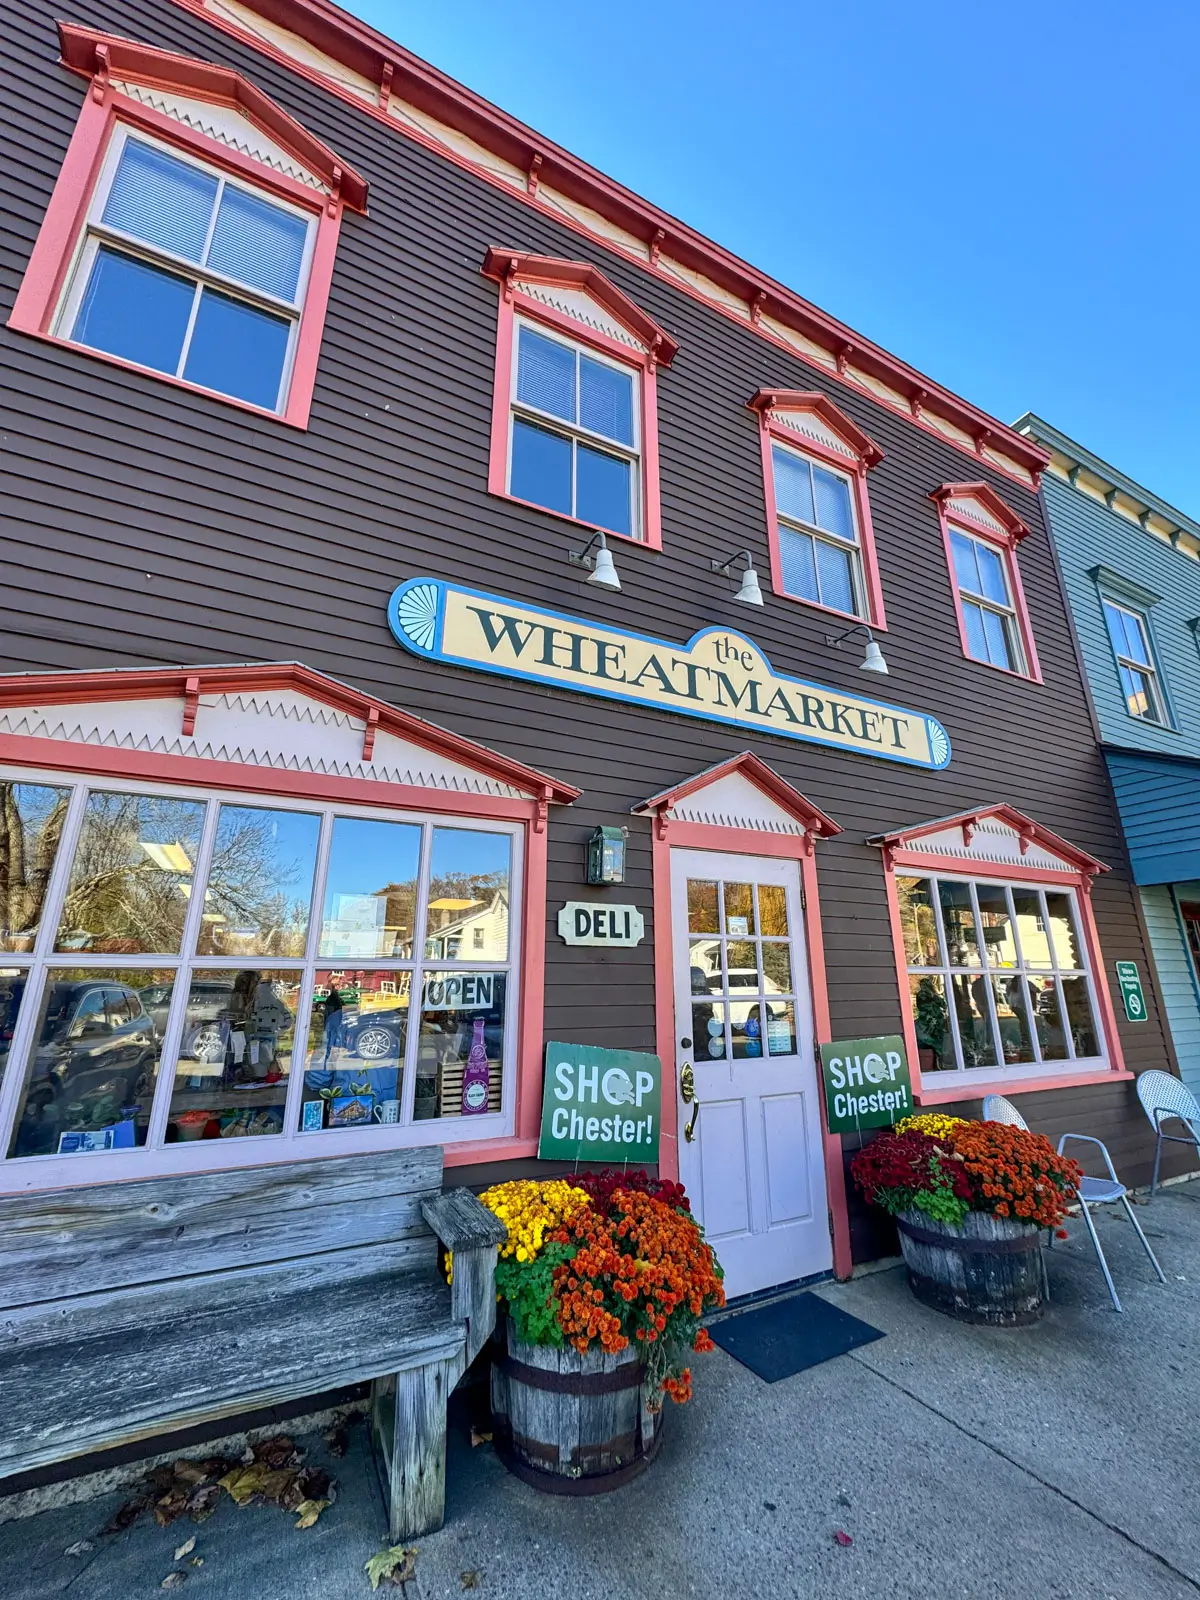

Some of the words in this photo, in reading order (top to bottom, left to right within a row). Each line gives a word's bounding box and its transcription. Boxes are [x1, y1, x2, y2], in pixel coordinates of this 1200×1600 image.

[712, 637, 754, 672] the
[574, 908, 631, 939] DELI
[427, 976, 491, 1006] OPEN
[553, 1062, 654, 1107] SHOP
[829, 1051, 902, 1089] SHOP
[834, 1084, 908, 1118] Chester!
[551, 1107, 653, 1145] Chester!
